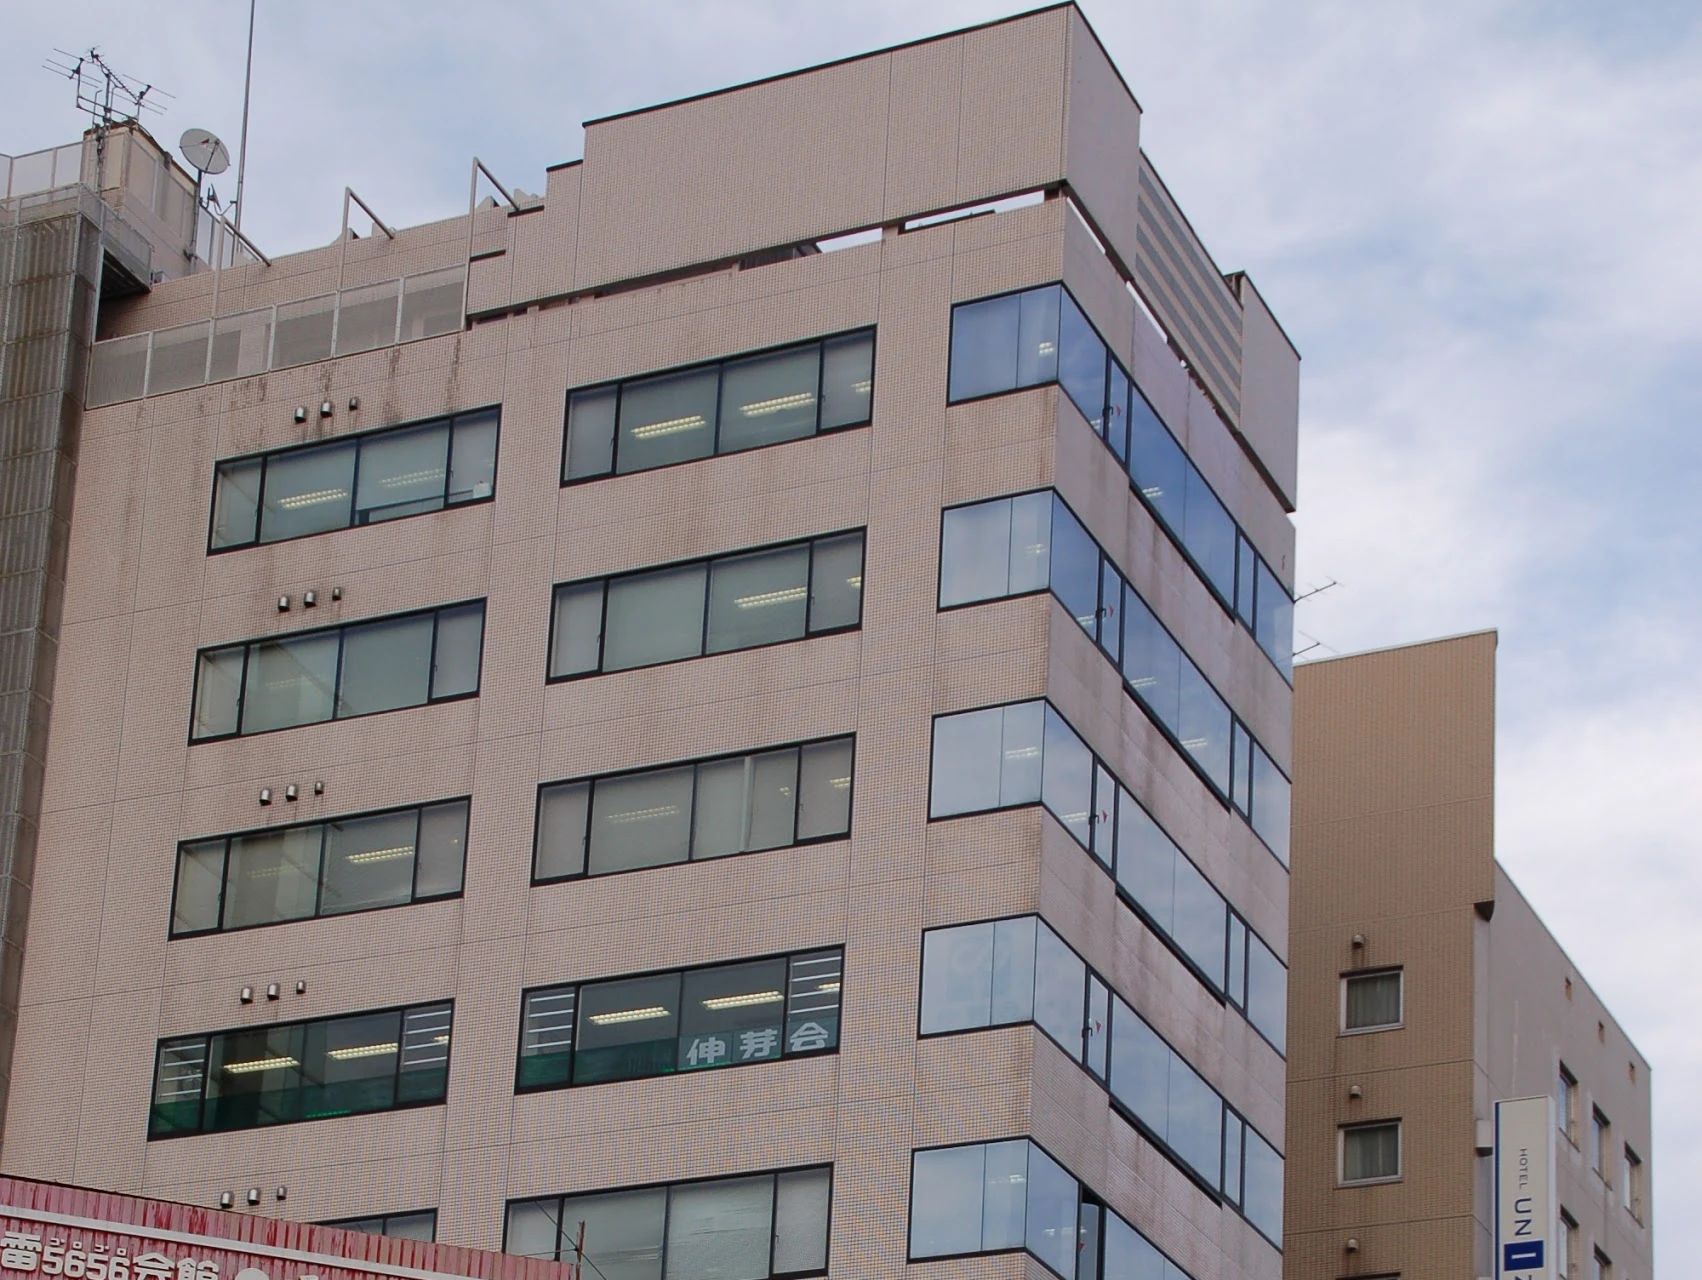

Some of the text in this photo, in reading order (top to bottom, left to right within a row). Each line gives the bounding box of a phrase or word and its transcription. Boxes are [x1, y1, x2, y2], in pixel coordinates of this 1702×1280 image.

[686, 1022, 828, 1065] 伸芽会
[1519, 1148, 1528, 1190] HOTEL
